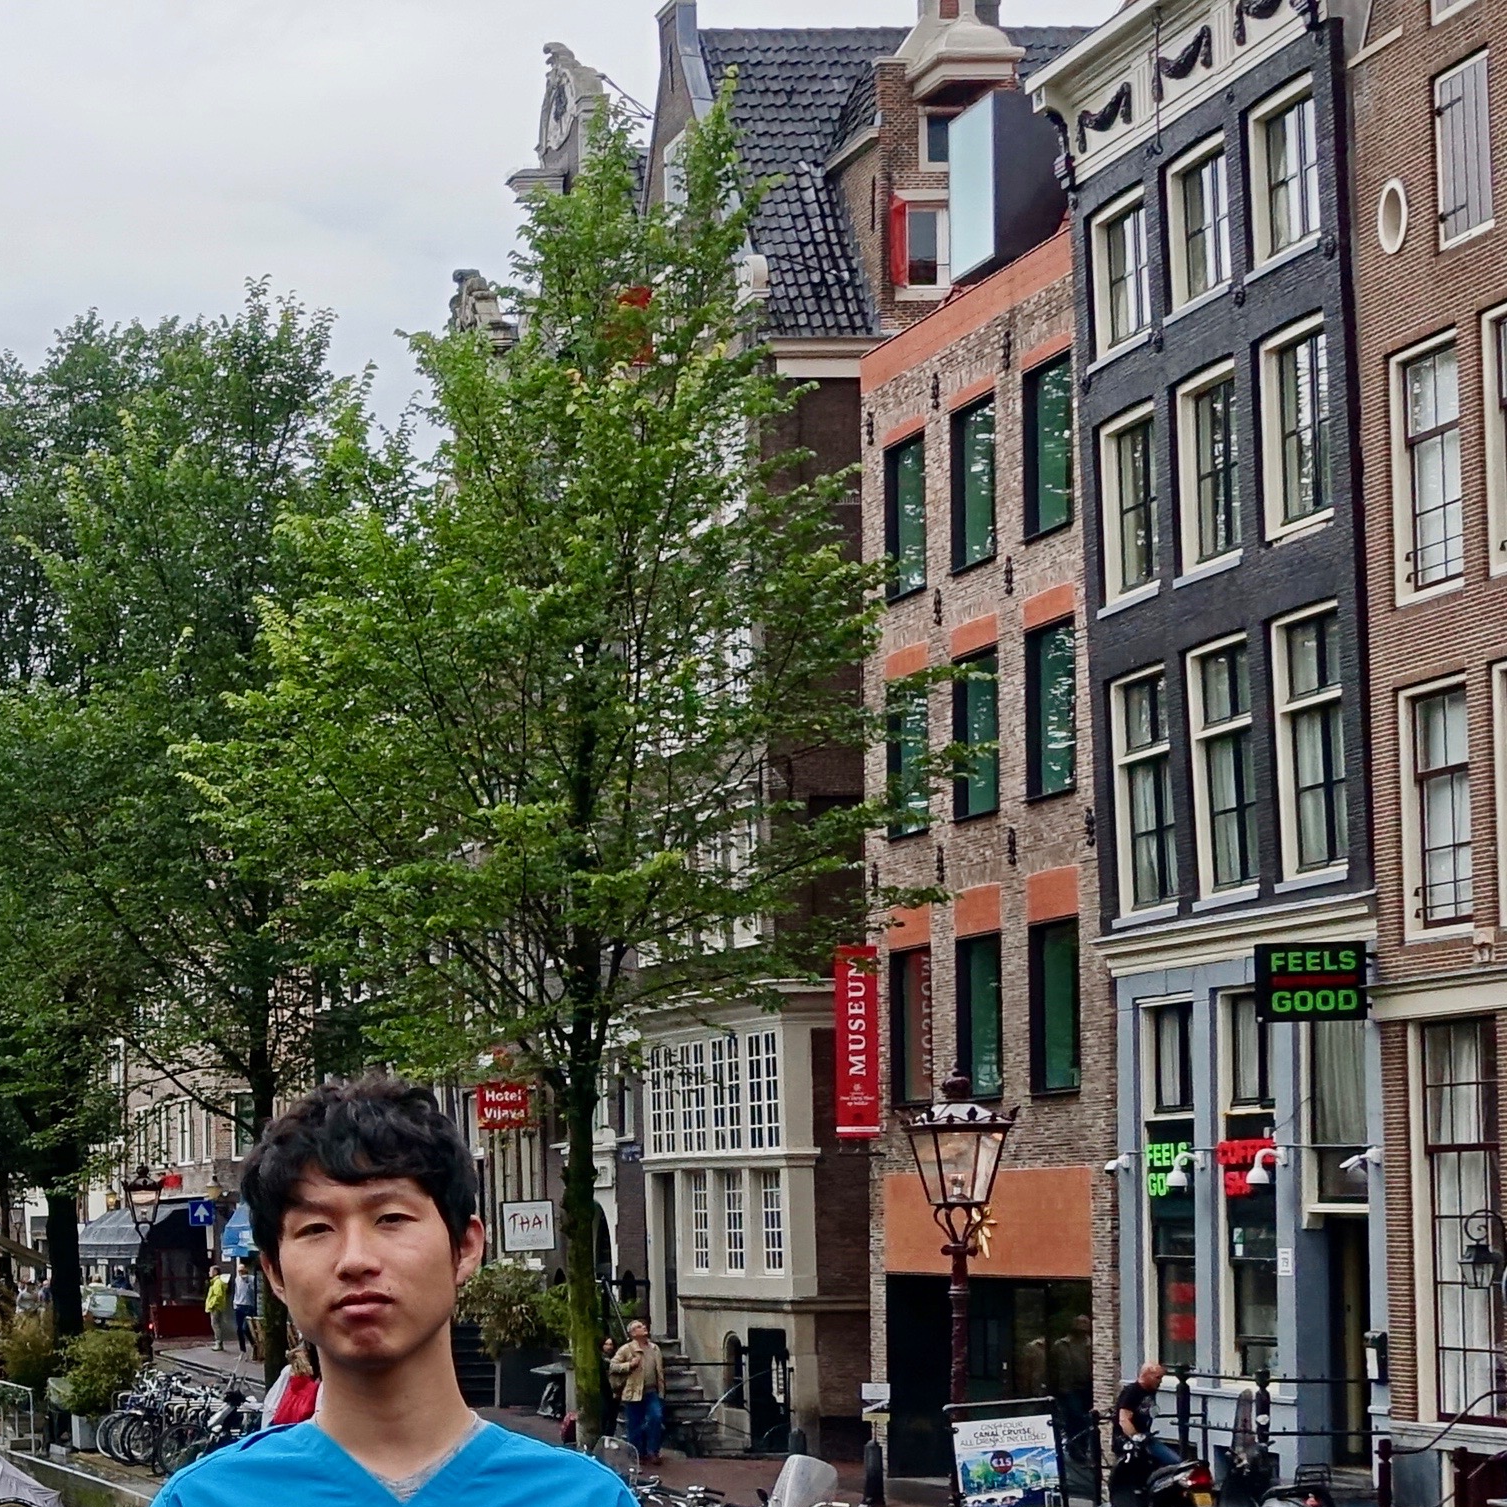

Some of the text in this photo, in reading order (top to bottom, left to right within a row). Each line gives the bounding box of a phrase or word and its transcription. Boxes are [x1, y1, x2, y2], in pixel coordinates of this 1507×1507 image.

[1270, 950, 1357, 972] FEELS
[1271, 989, 1358, 1013] GOOD
[485, 1088, 522, 1102] Hotel
[1145, 1142, 1188, 1167] FEELS
[508, 1212, 549, 1235] THAI
